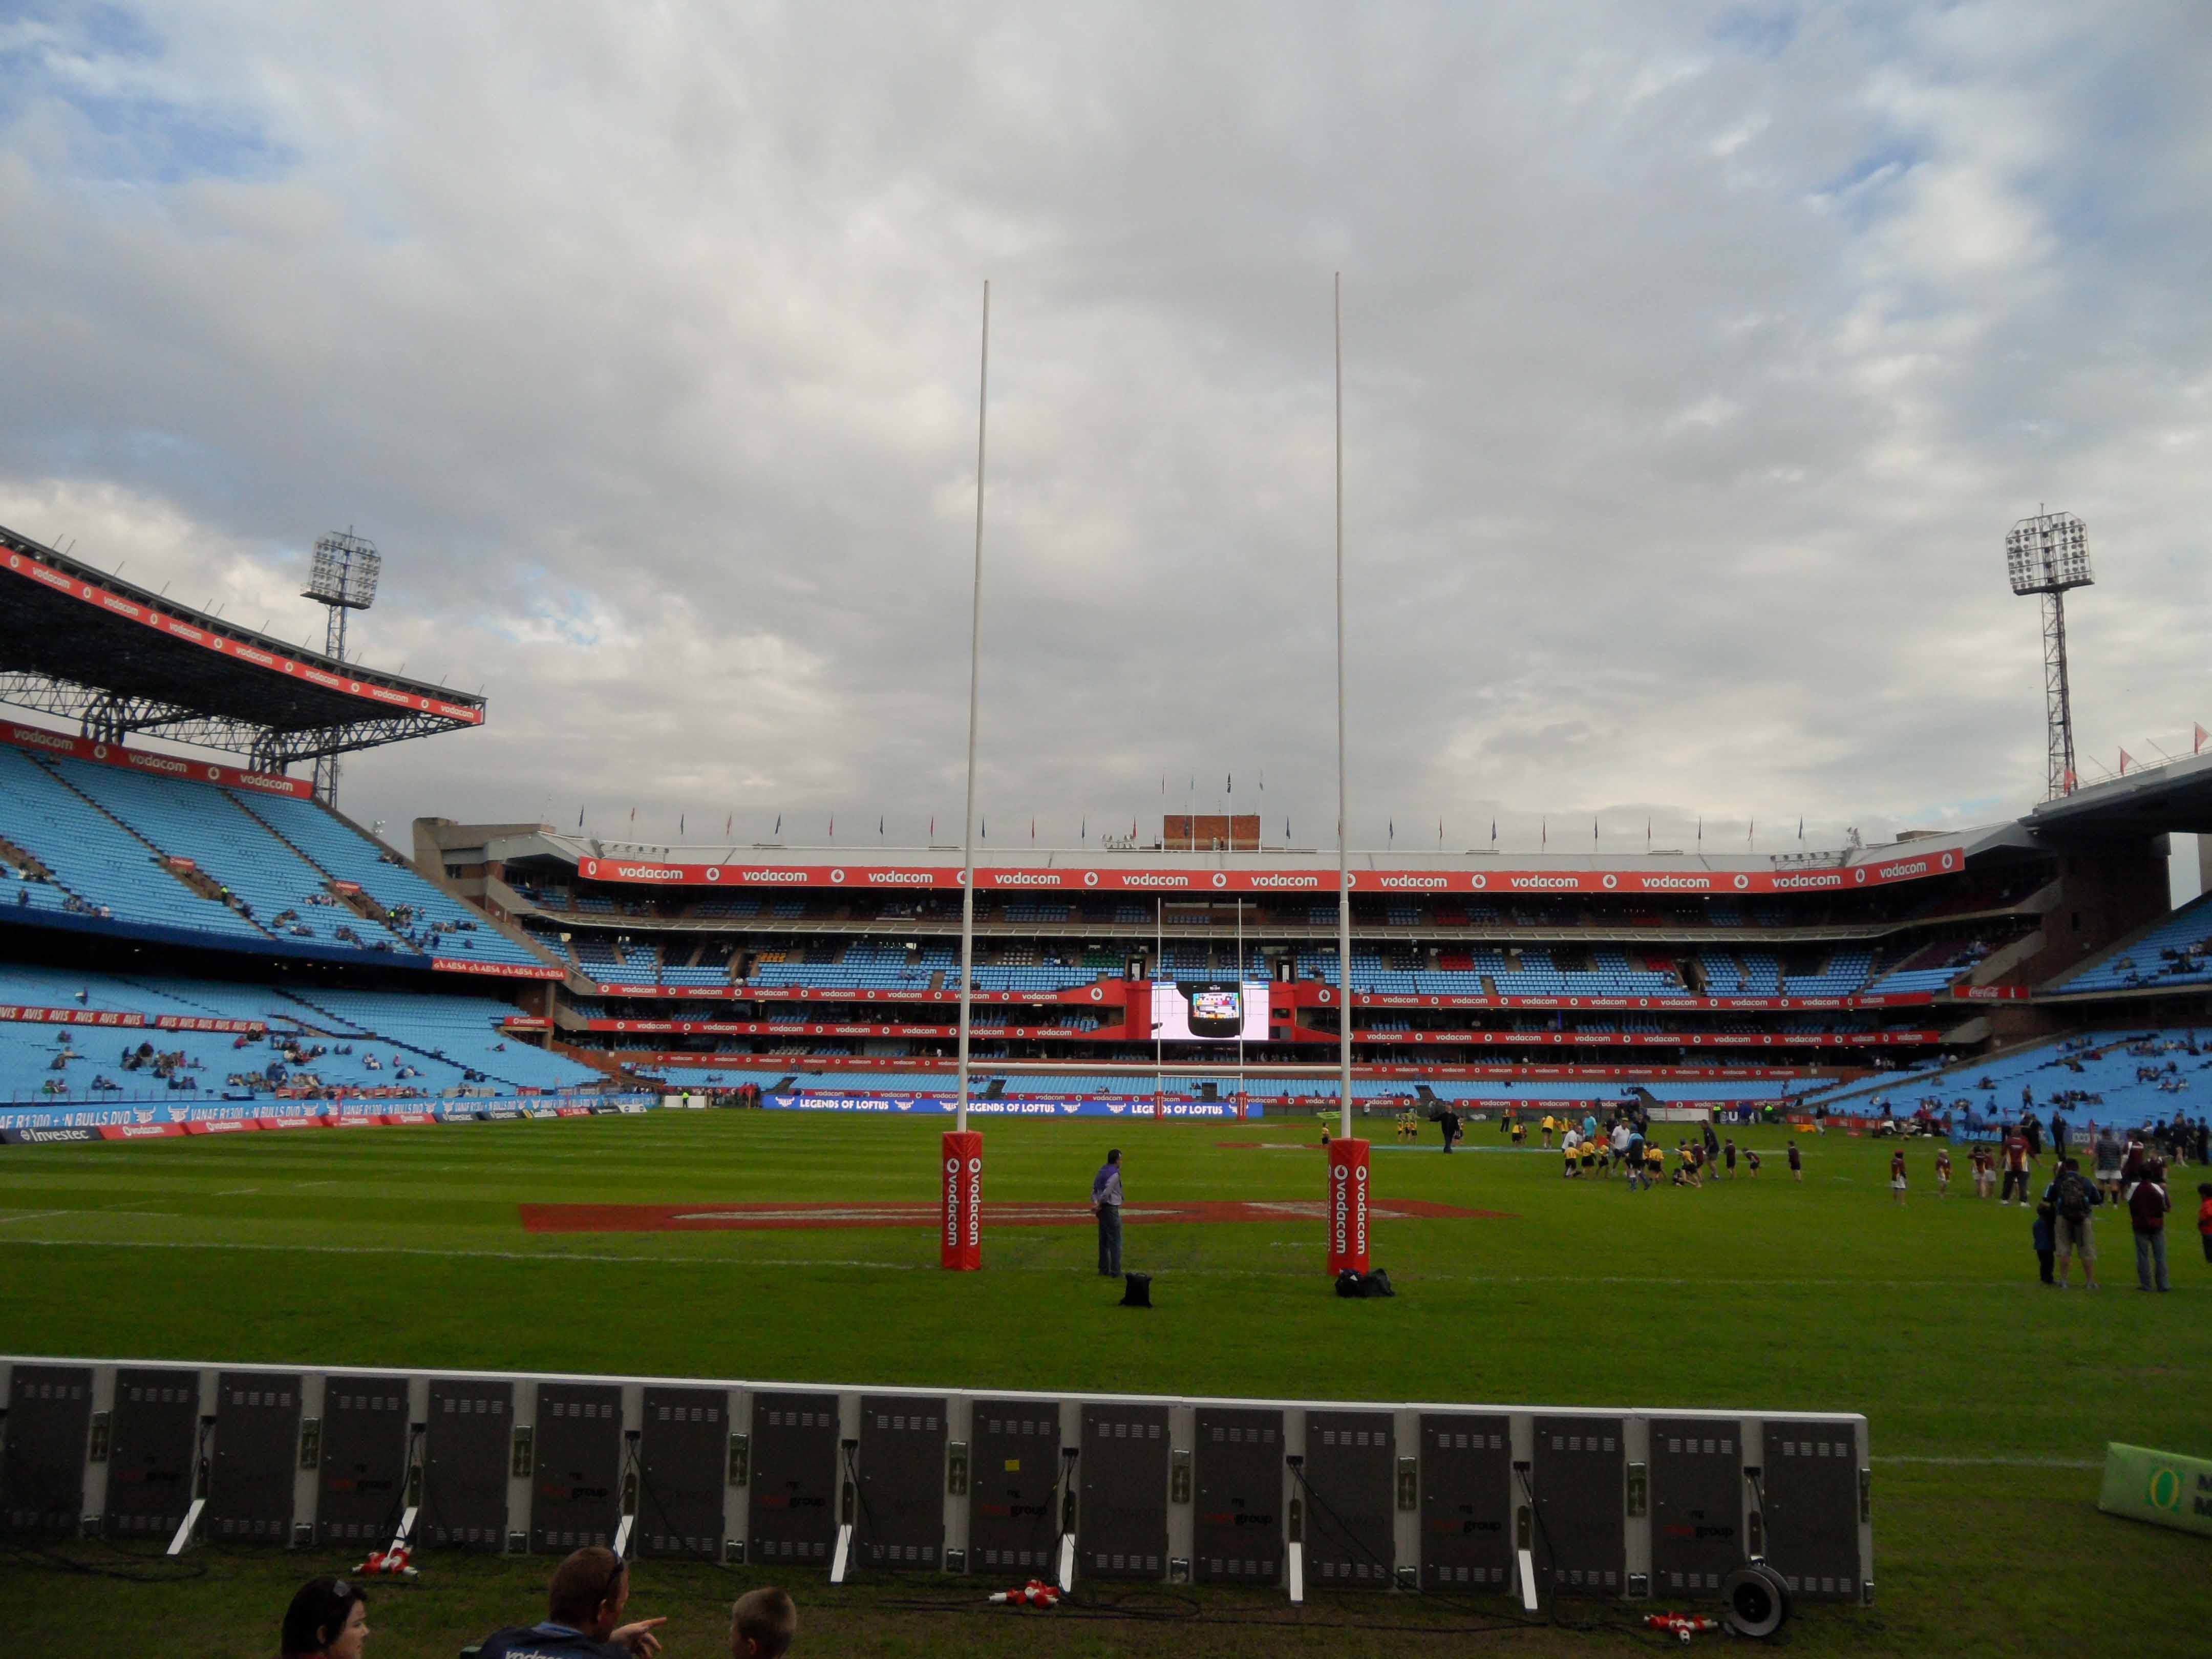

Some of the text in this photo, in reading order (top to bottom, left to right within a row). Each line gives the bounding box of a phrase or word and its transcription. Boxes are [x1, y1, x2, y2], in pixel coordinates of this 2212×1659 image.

[33, 567, 473, 719] vodacom vodacom vodacom vodacom vodacom vodacom vodacom
[14, 727, 294, 792] vodacom vodacom vodacom
[618, 862, 1926, 888] vodacom vodacom vodacom vodacom vodacom vodacom vodacom vodacom vodacom vodacom vodacom
[446, 962, 466, 970] ABSA
[622, 986, 657, 994] vodacom
[22, 1008, 44, 1020] AVIS
[49, 1010, 70, 1021] AVIS
[74, 1011, 94, 1023] AVIS
[99, 1013, 118, 1024] AVIS
[123, 1014, 141, 1025] AVIS
[160, 1016, 177, 1027] AVIS
[179, 1017, 196, 1028] AVIS
[197, 1019, 213, 1029] AVIS
[215, 1020, 230, 1030] AVIS
[232, 1020, 247, 1031] AVIS
[815, 1090, 844, 1098] vodacom
[800, 1099, 839, 1109] LEGENDS
[841, 1100, 854, 1109] OF
[856, 1100, 889, 1110] LOFTUS
[966, 1103, 1004, 1112] LEGENDS
[1007, 1103, 1019, 1112] OF
[1022, 1103, 1055, 1113] LOFTUS
[1132, 1105, 1170, 1114] LEGEDS
[1174, 1105, 1187, 1114] OF
[1189, 1105, 1223, 1115] LOFTUS
[75, 1111, 109, 1126] BULLS
[110, 1111, 131, 1125] DVD
[191, 1108, 218, 1121] VANAF
[260, 1105, 285, 1118] BULLS
[128, 1125, 164, 1136] vodacom
[211, 1122, 242, 1131] vodacom
[29, 1128, 89, 1142] Investec
[948, 1174, 960, 1246] vodacom
[970, 1174, 981, 1246] vodacom
[1336, 1181, 1349, 1253] vodacom
[1357, 1182, 1367, 1254] vodacom
